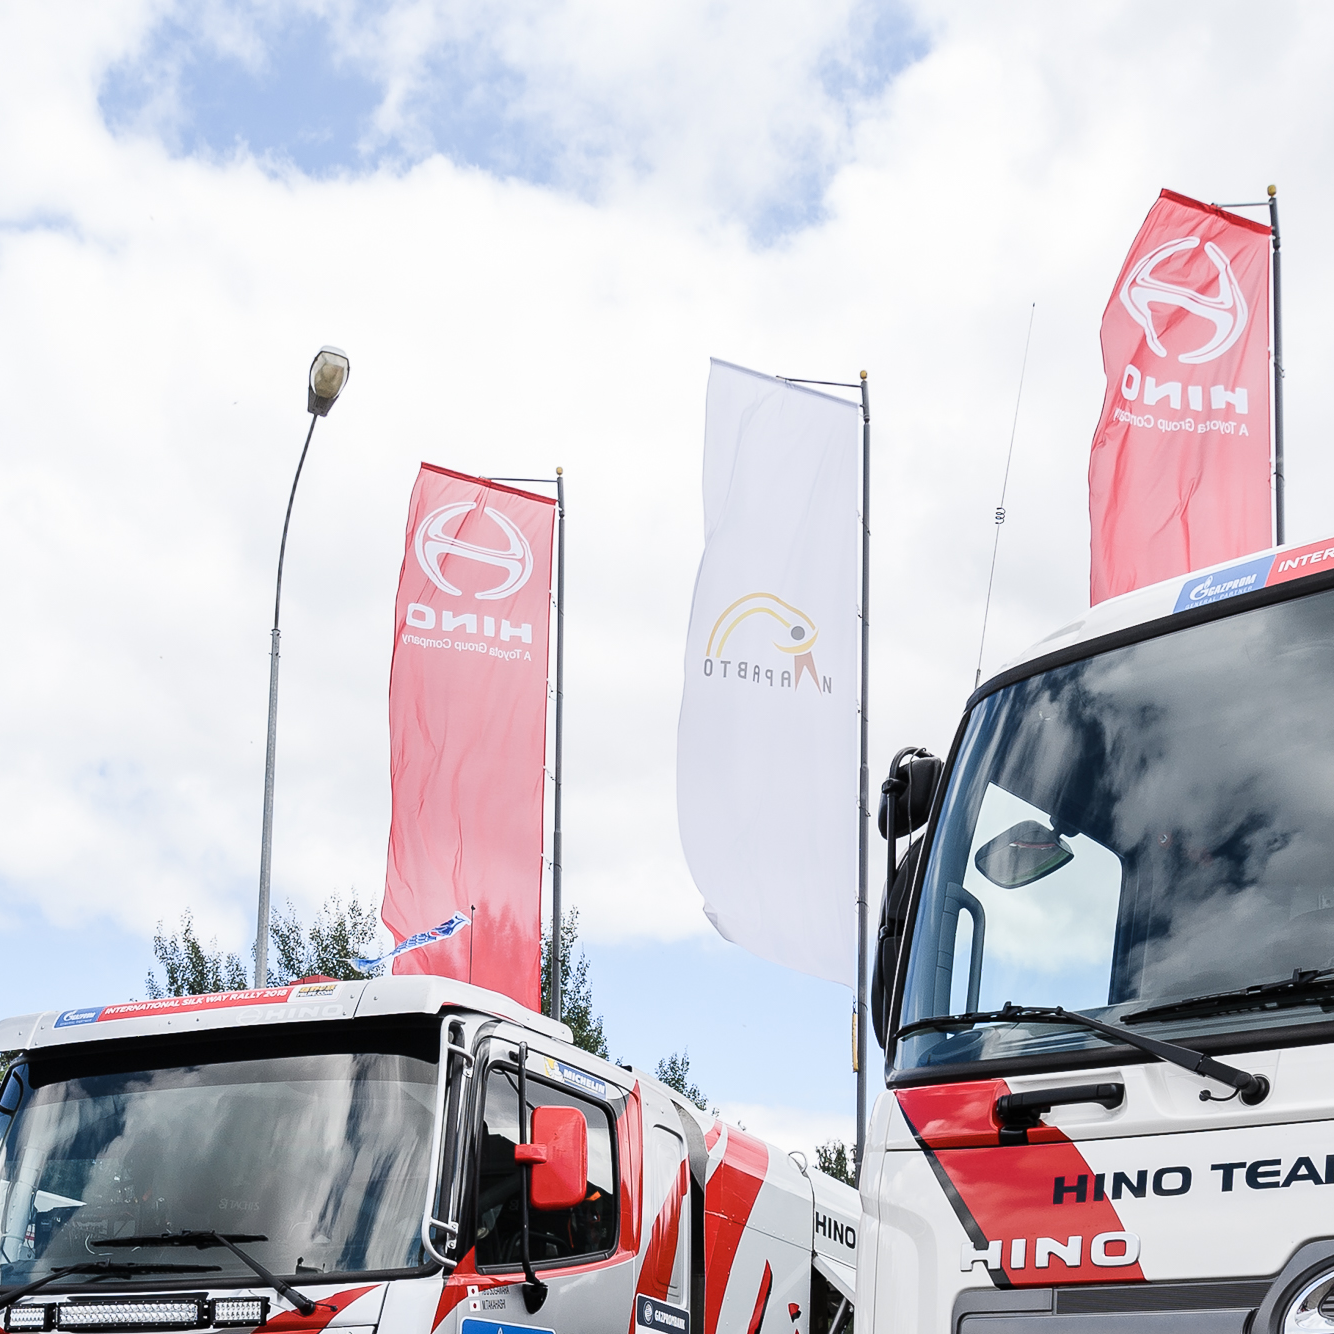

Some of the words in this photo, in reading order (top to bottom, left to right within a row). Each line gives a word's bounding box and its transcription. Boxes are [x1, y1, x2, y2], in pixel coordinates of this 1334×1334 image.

[1207, 574, 1257, 597] GAZPROM
[104, 998, 180, 1015] INTERNATIONAL
[182, 996, 204, 1006] SILK
[205, 993, 230, 1004] WAY
[229, 990, 263, 1002] RALLY
[263, 988, 288, 998] 2018
[265, 1004, 345, 1020] HINO
[563, 1068, 606, 1094] MICHELIN
[1052, 1164, 1193, 1205] HINO
[815, 1211, 856, 1250] HINO
[959, 1230, 1141, 1273] HINO
